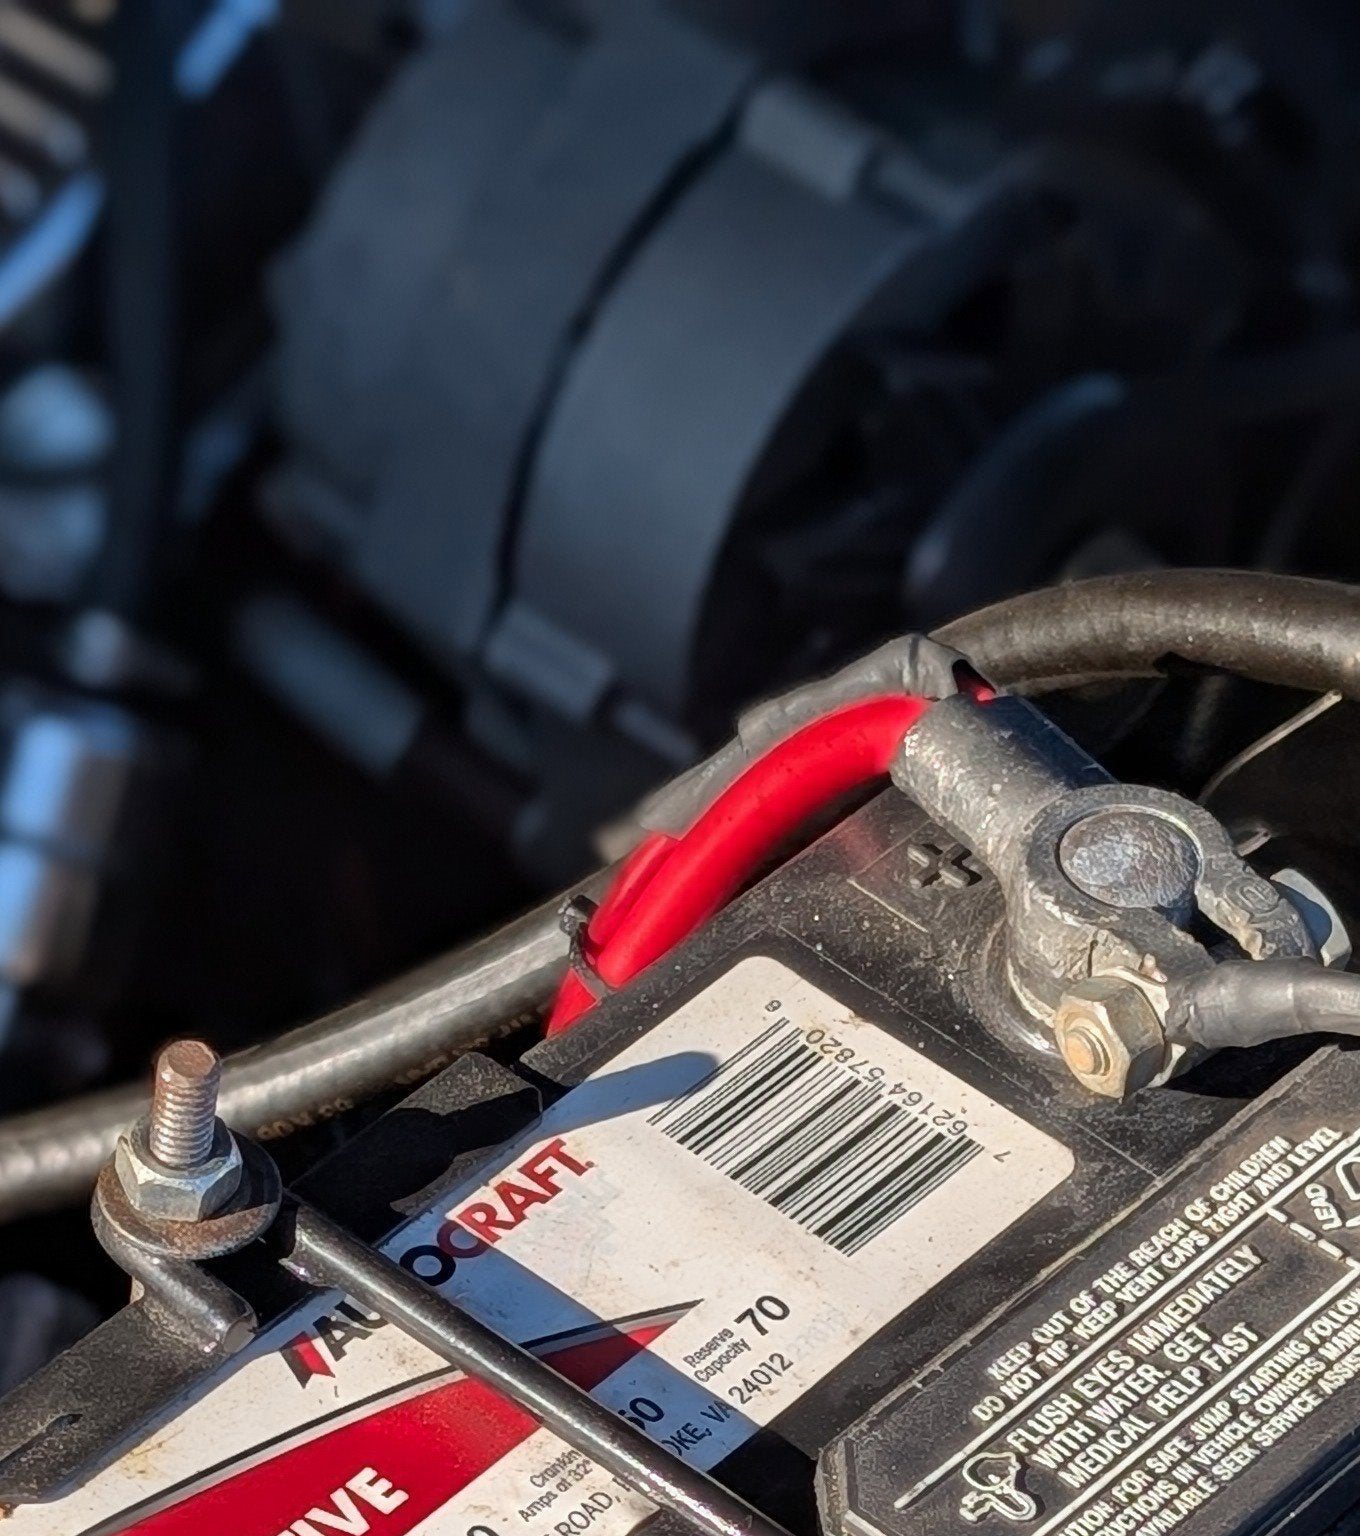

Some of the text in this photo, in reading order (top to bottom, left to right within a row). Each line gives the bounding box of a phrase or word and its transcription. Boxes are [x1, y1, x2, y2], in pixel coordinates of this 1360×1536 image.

[806, 1029, 884, 1090] 57820
[888, 1081, 968, 1145] 62164
[1304, 1183, 1342, 1231] LEAD
[313, 1138, 591, 1362] AUOCRAFT
[972, 1127, 1342, 1421] DO NOT TIP. KEEP VENT CAPS TIGHT AND LEVEL
[987, 1136, 1291, 1380] KEEP OUT OF THE REACH OF CHILDREN
[683, 1329, 734, 1368] Reserve
[734, 1294, 790, 1337] 70
[1007, 1245, 1260, 1453] FLUSH EYES IMMEDIATELY
[694, 1338, 751, 1382] Capacity
[701, 1399, 738, 1425] VA
[729, 1353, 793, 1404] 24012
[1032, 1322, 1211, 1468] WITH WATER. GET
[1058, 1322, 1258, 1488] MEDICAL HELP FAST
[1112, 1470, 1153, 1502] FOR
[1146, 1436, 1193, 1473] SAFE
[1189, 1401, 1233, 1440] JUMP
[1230, 1340, 1310, 1404] STARTING
[1172, 1463, 1198, 1483] IN
[1191, 1412, 1260, 1464] VEHICLE
[1254, 1357, 1325, 1414] OWNERS
[1212, 1442, 1259, 1480] SEEK
[1252, 1389, 1322, 1446] SERVICE
[519, 1491, 557, 1522] Amps
[555, 1477, 573, 1492] at
[530, 1443, 582, 1487] Crankin
